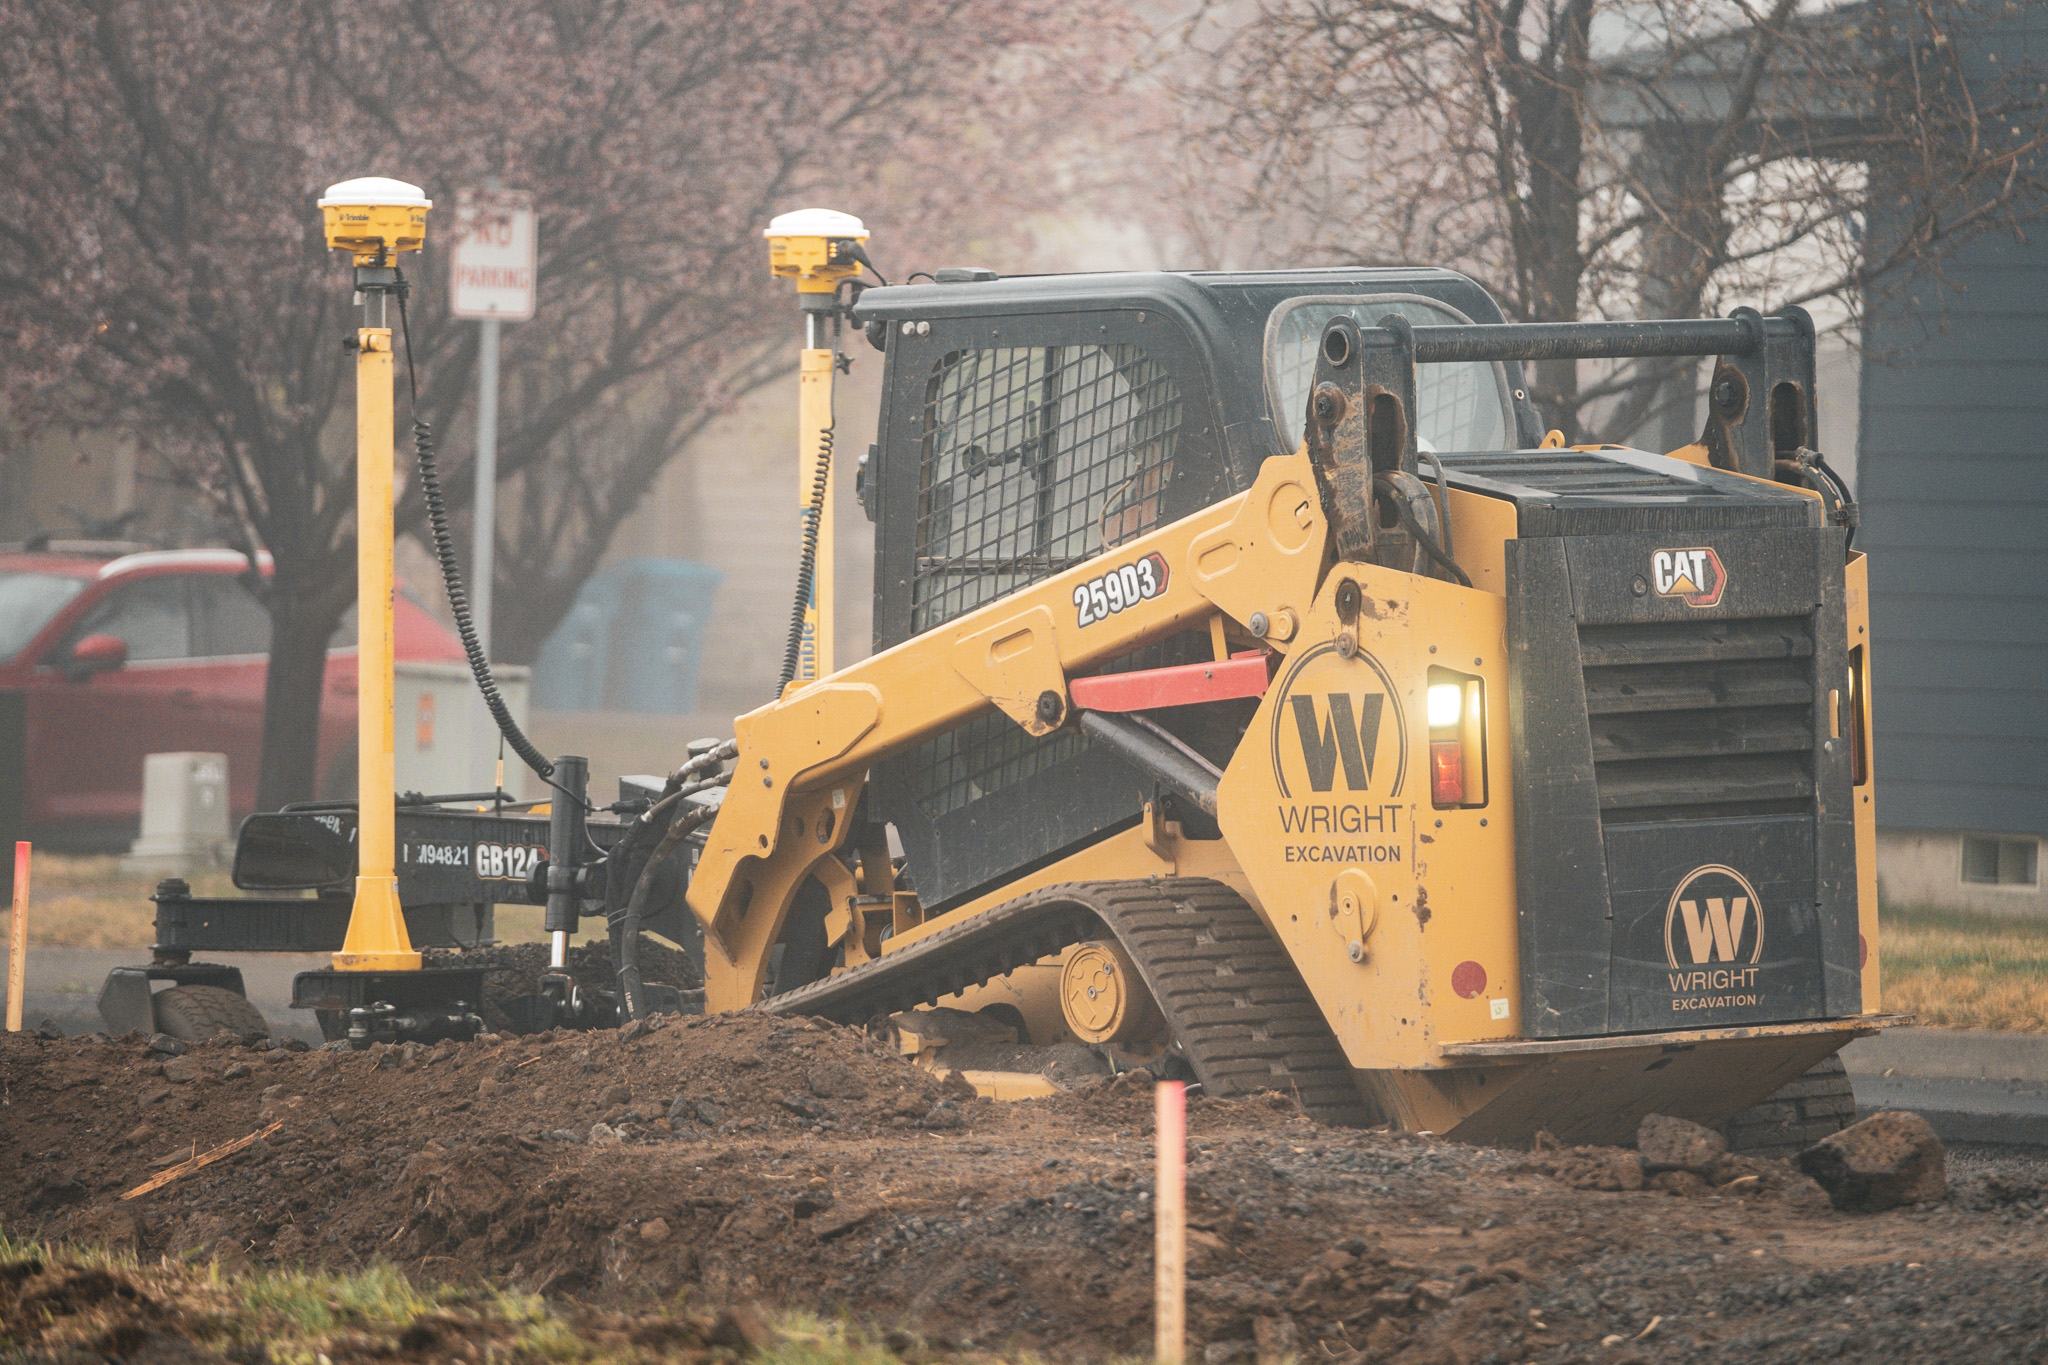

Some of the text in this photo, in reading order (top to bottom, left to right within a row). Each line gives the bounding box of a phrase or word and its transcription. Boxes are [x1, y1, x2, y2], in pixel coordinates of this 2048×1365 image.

[456, 265, 529, 289] PARKING
[1653, 550, 1707, 594] CAT
[1074, 558, 1157, 627] 259D3
[802, 622, 816, 681] mble
[1291, 693, 1384, 792] W
[1278, 804, 1403, 834] WRIGHT
[1285, 845, 1401, 863] EXCAVATION
[1679, 896, 1748, 964] W
[1668, 967, 1759, 992] WRIGHT
[1672, 994, 1757, 1011] EXCAVATION
